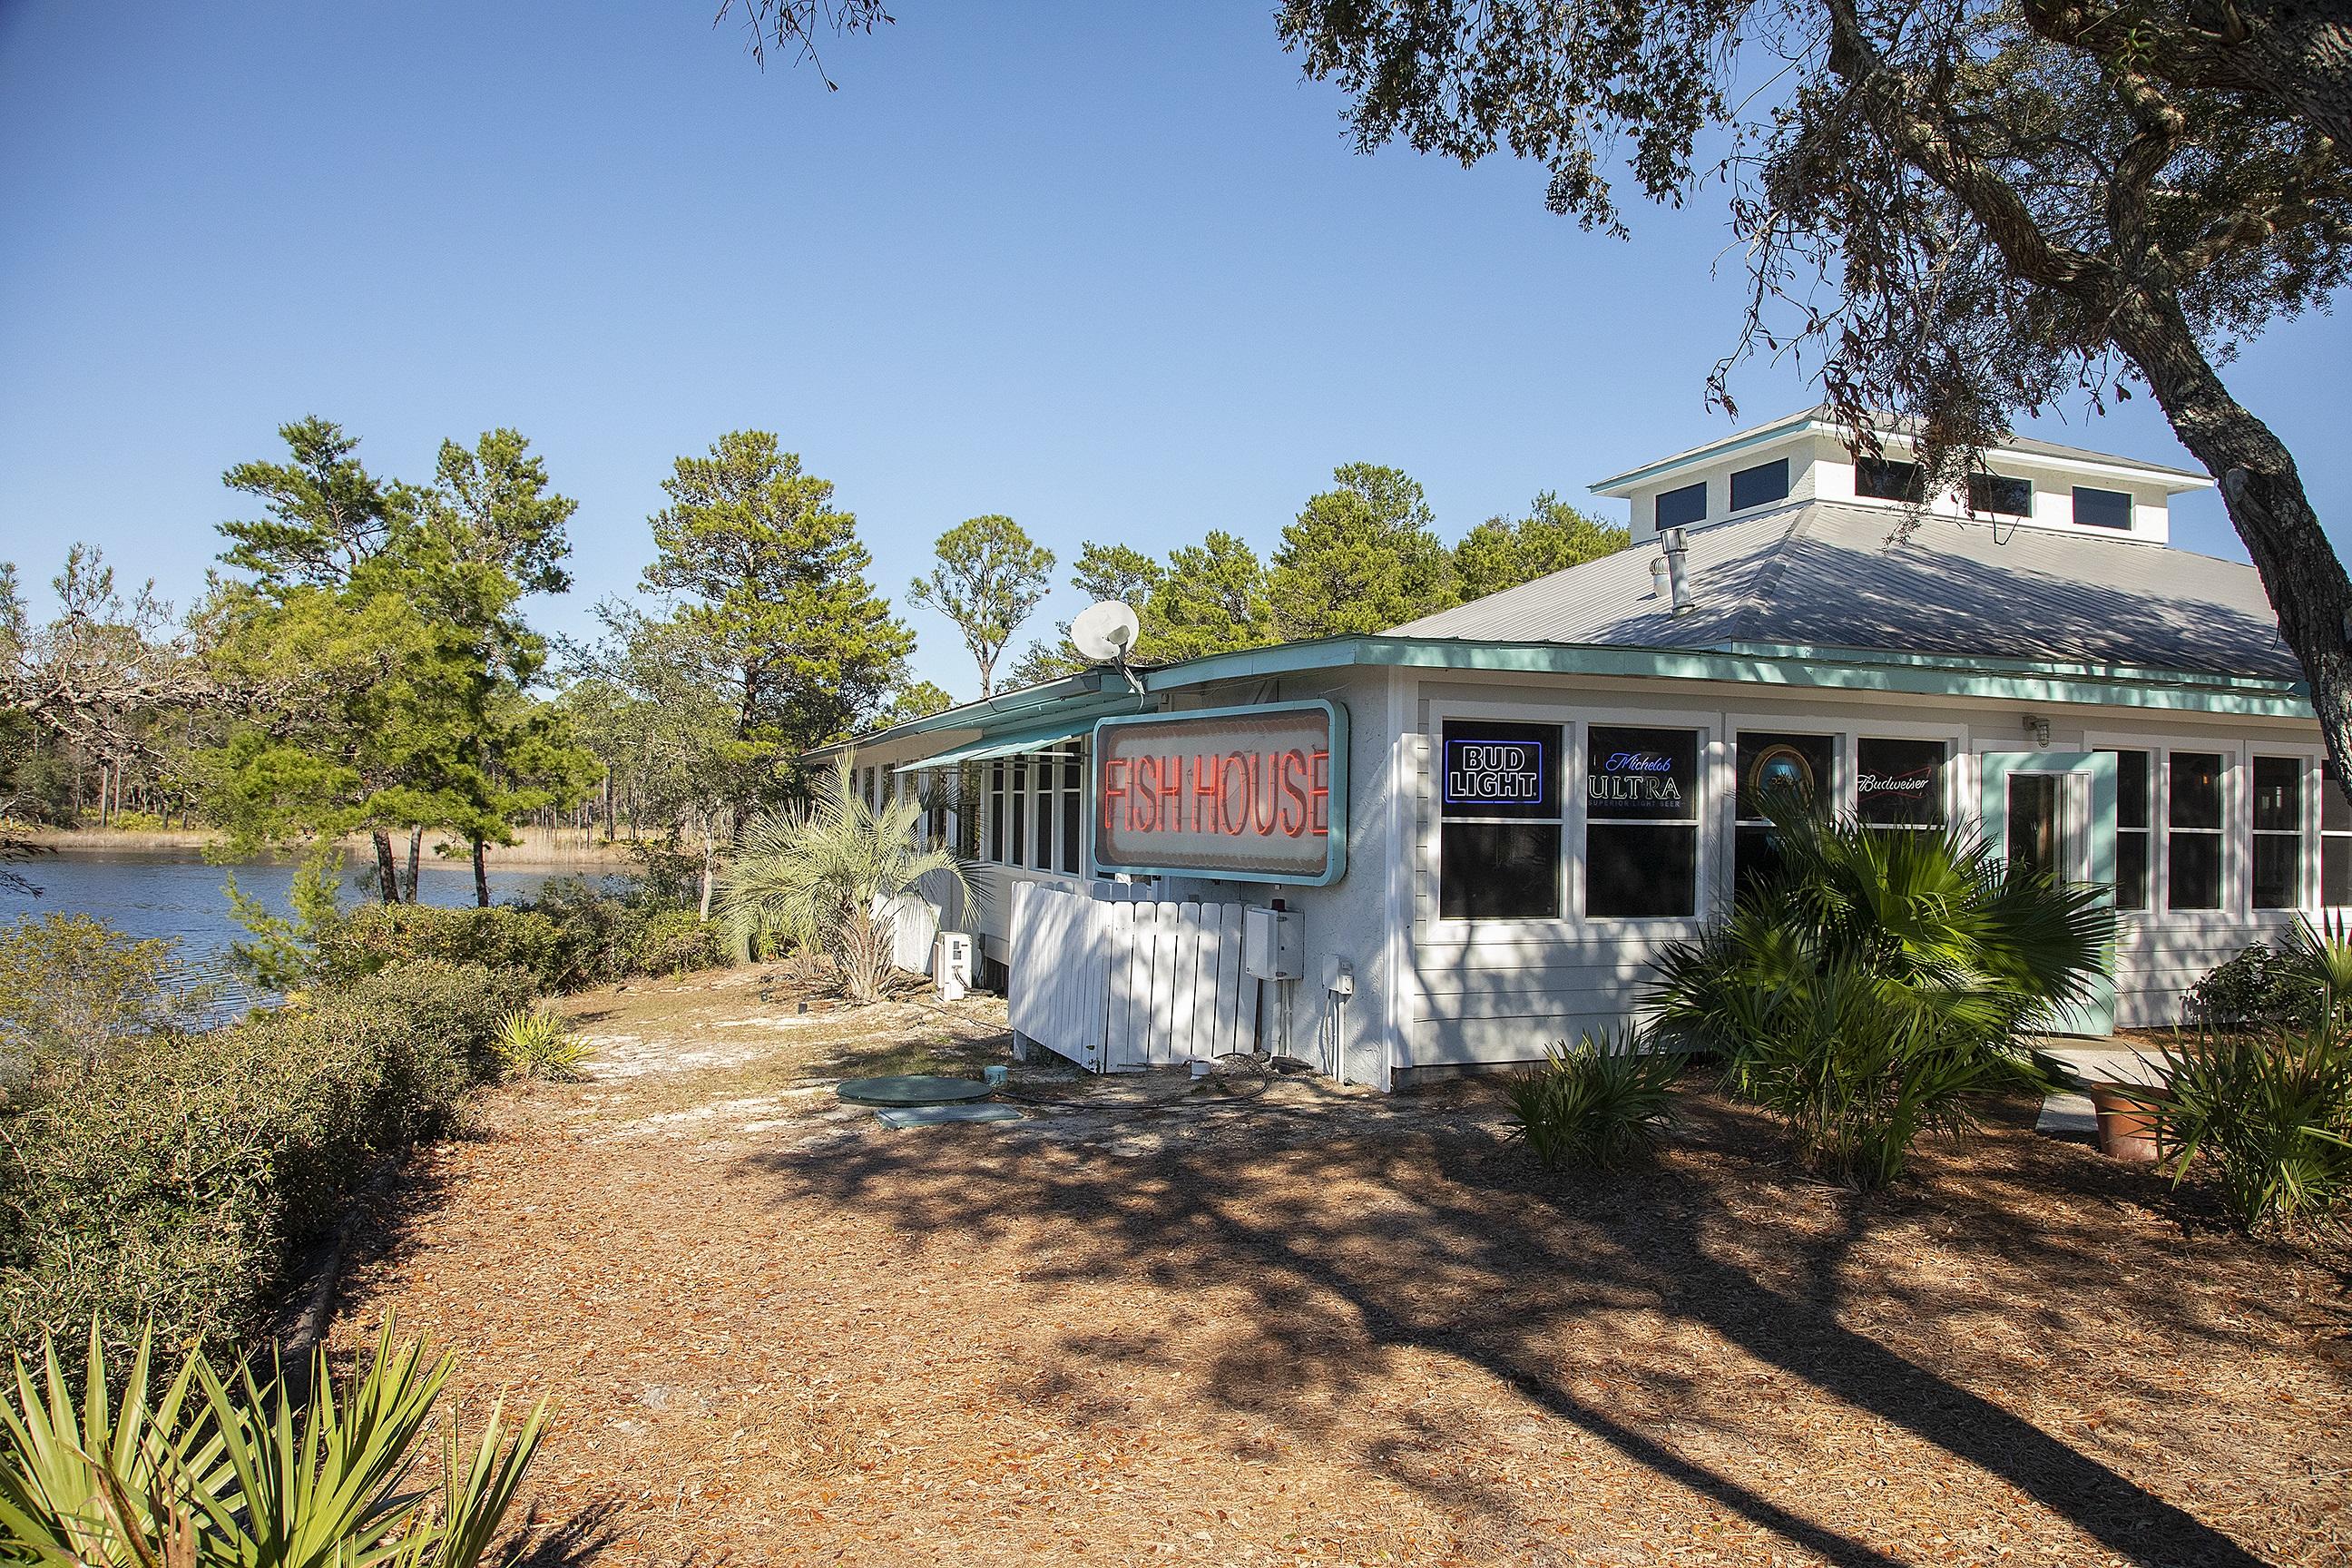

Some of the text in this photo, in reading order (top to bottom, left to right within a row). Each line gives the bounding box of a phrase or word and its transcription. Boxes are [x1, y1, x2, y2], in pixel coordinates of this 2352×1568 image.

[1463, 746, 1525, 771] BUD
[1605, 752, 1672, 772] Michelob
[1104, 749, 1328, 838] FISH HOUSE
[1450, 771, 1537, 798] LIGHT
[1588, 775, 1681, 799] ULTRA
[1857, 774, 1928, 792] Budweiser
[1632, 799, 1656, 808] LIGHT
[1661, 800, 1681, 808] BEER
